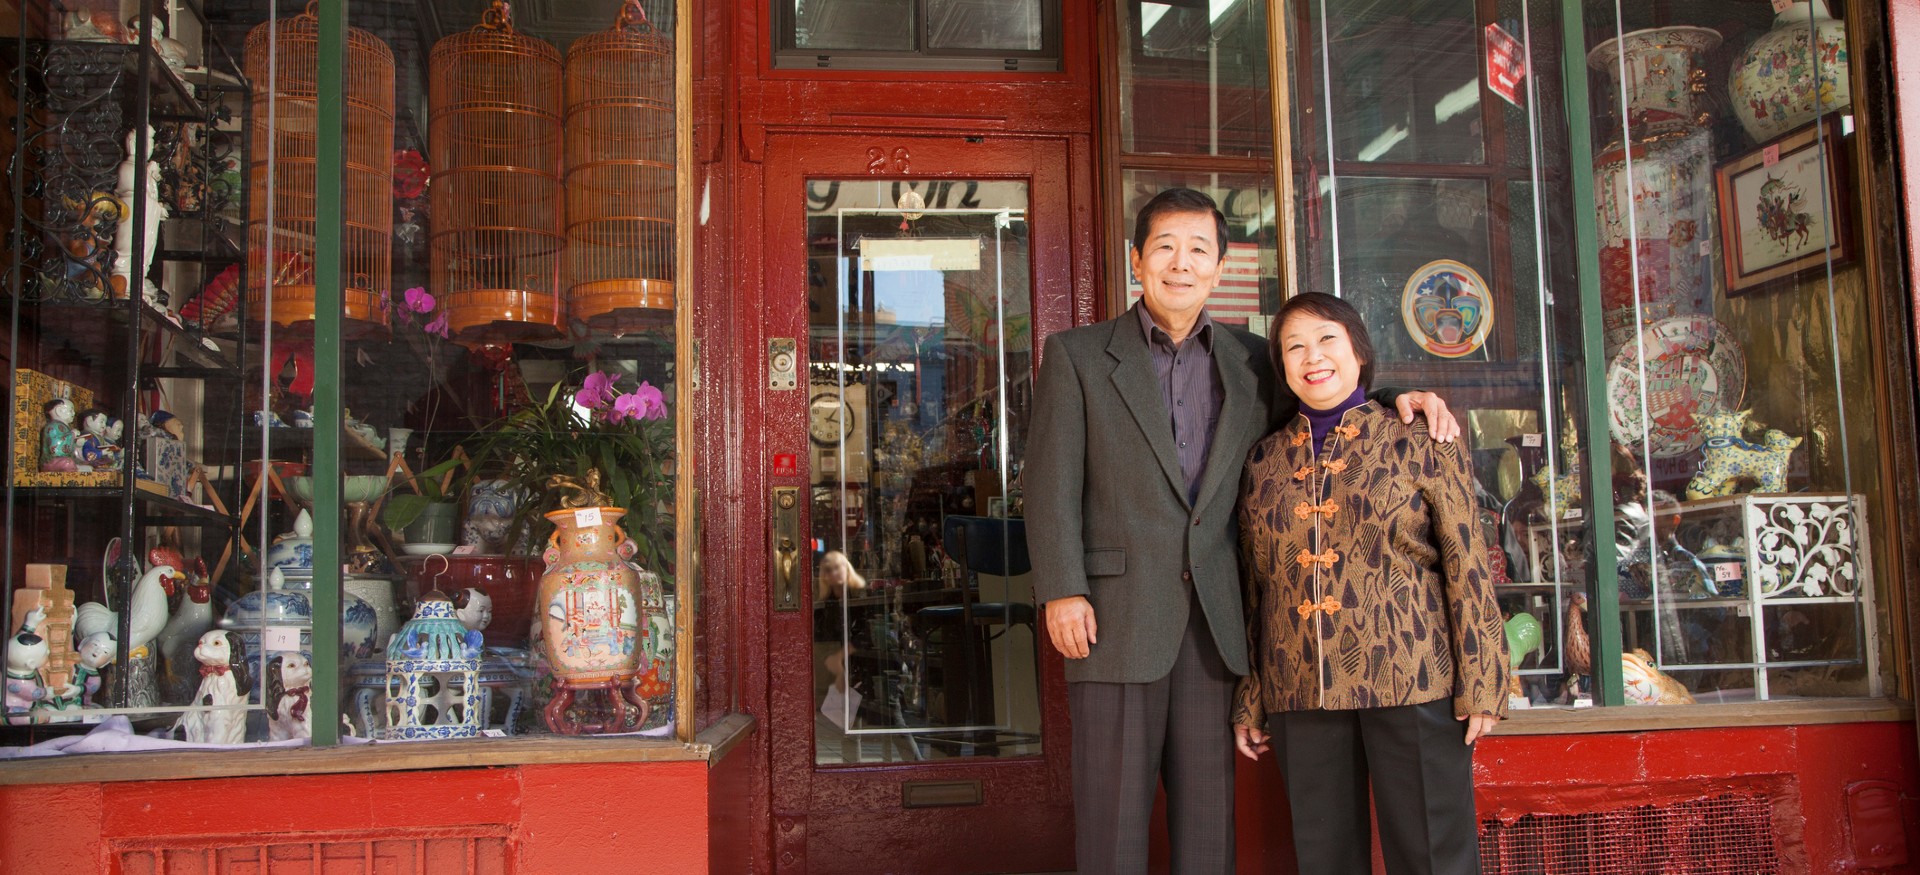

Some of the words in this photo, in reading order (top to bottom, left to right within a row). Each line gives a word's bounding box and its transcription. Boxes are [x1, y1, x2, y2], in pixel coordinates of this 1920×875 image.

[865, 146, 910, 174] 26
[775, 467, 794, 475] PUSH
[585, 512, 594, 522] 15
[277, 634, 286, 644] 19
